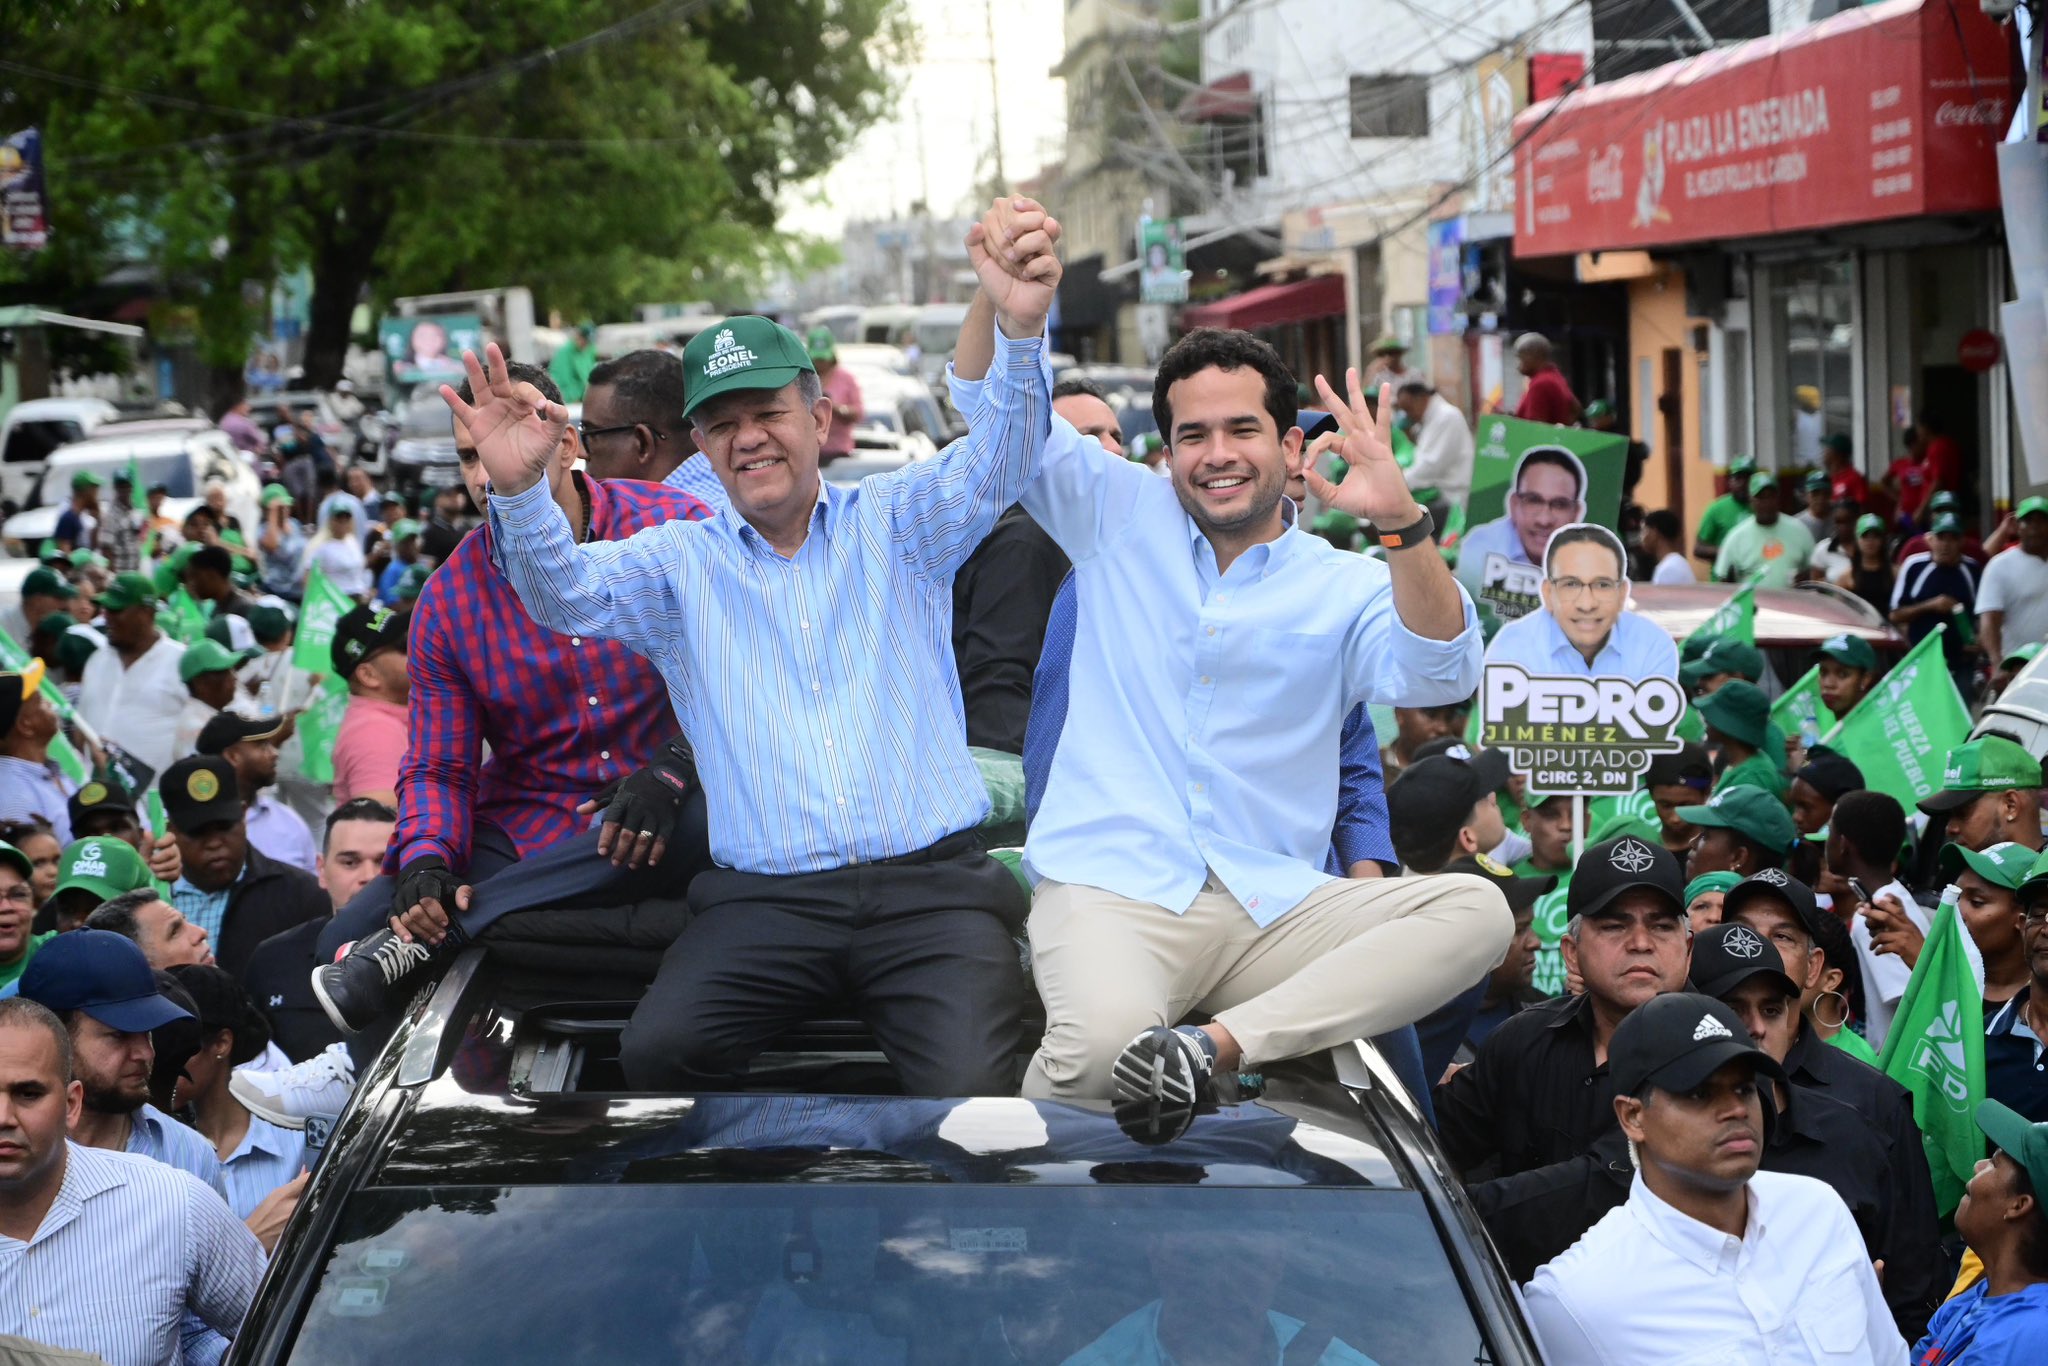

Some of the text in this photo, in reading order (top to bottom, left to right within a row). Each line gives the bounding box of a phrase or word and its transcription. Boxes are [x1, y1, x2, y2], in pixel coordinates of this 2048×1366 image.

[1665, 114, 1713, 164] PLAZA
[1714, 109, 1736, 156] LA
[1738, 85, 1831, 151] ENSENADA
[1935, 99, 2006, 126] Coca-Cola
[703, 350, 758, 375] LEONEL
[709, 360, 752, 378] PRESIDENTE
[1484, 555, 1542, 595] PED
[1486, 666, 1680, 739] PEDRO
[1486, 724, 1617, 742] JIMÉNEZ
[1898, 699, 1932, 756] FUERZA
[1517, 749, 1645, 768] DIPUTADO
[1891, 738, 1931, 797] PUEBLO
[1537, 771, 1627, 787] CIRC 2, DN
[1944, 765, 1962, 778] nel
[72, 860, 107, 871] OMAR
[1693, 1028, 1733, 1041] adidas
[1918, 1046, 1968, 1101] FP
